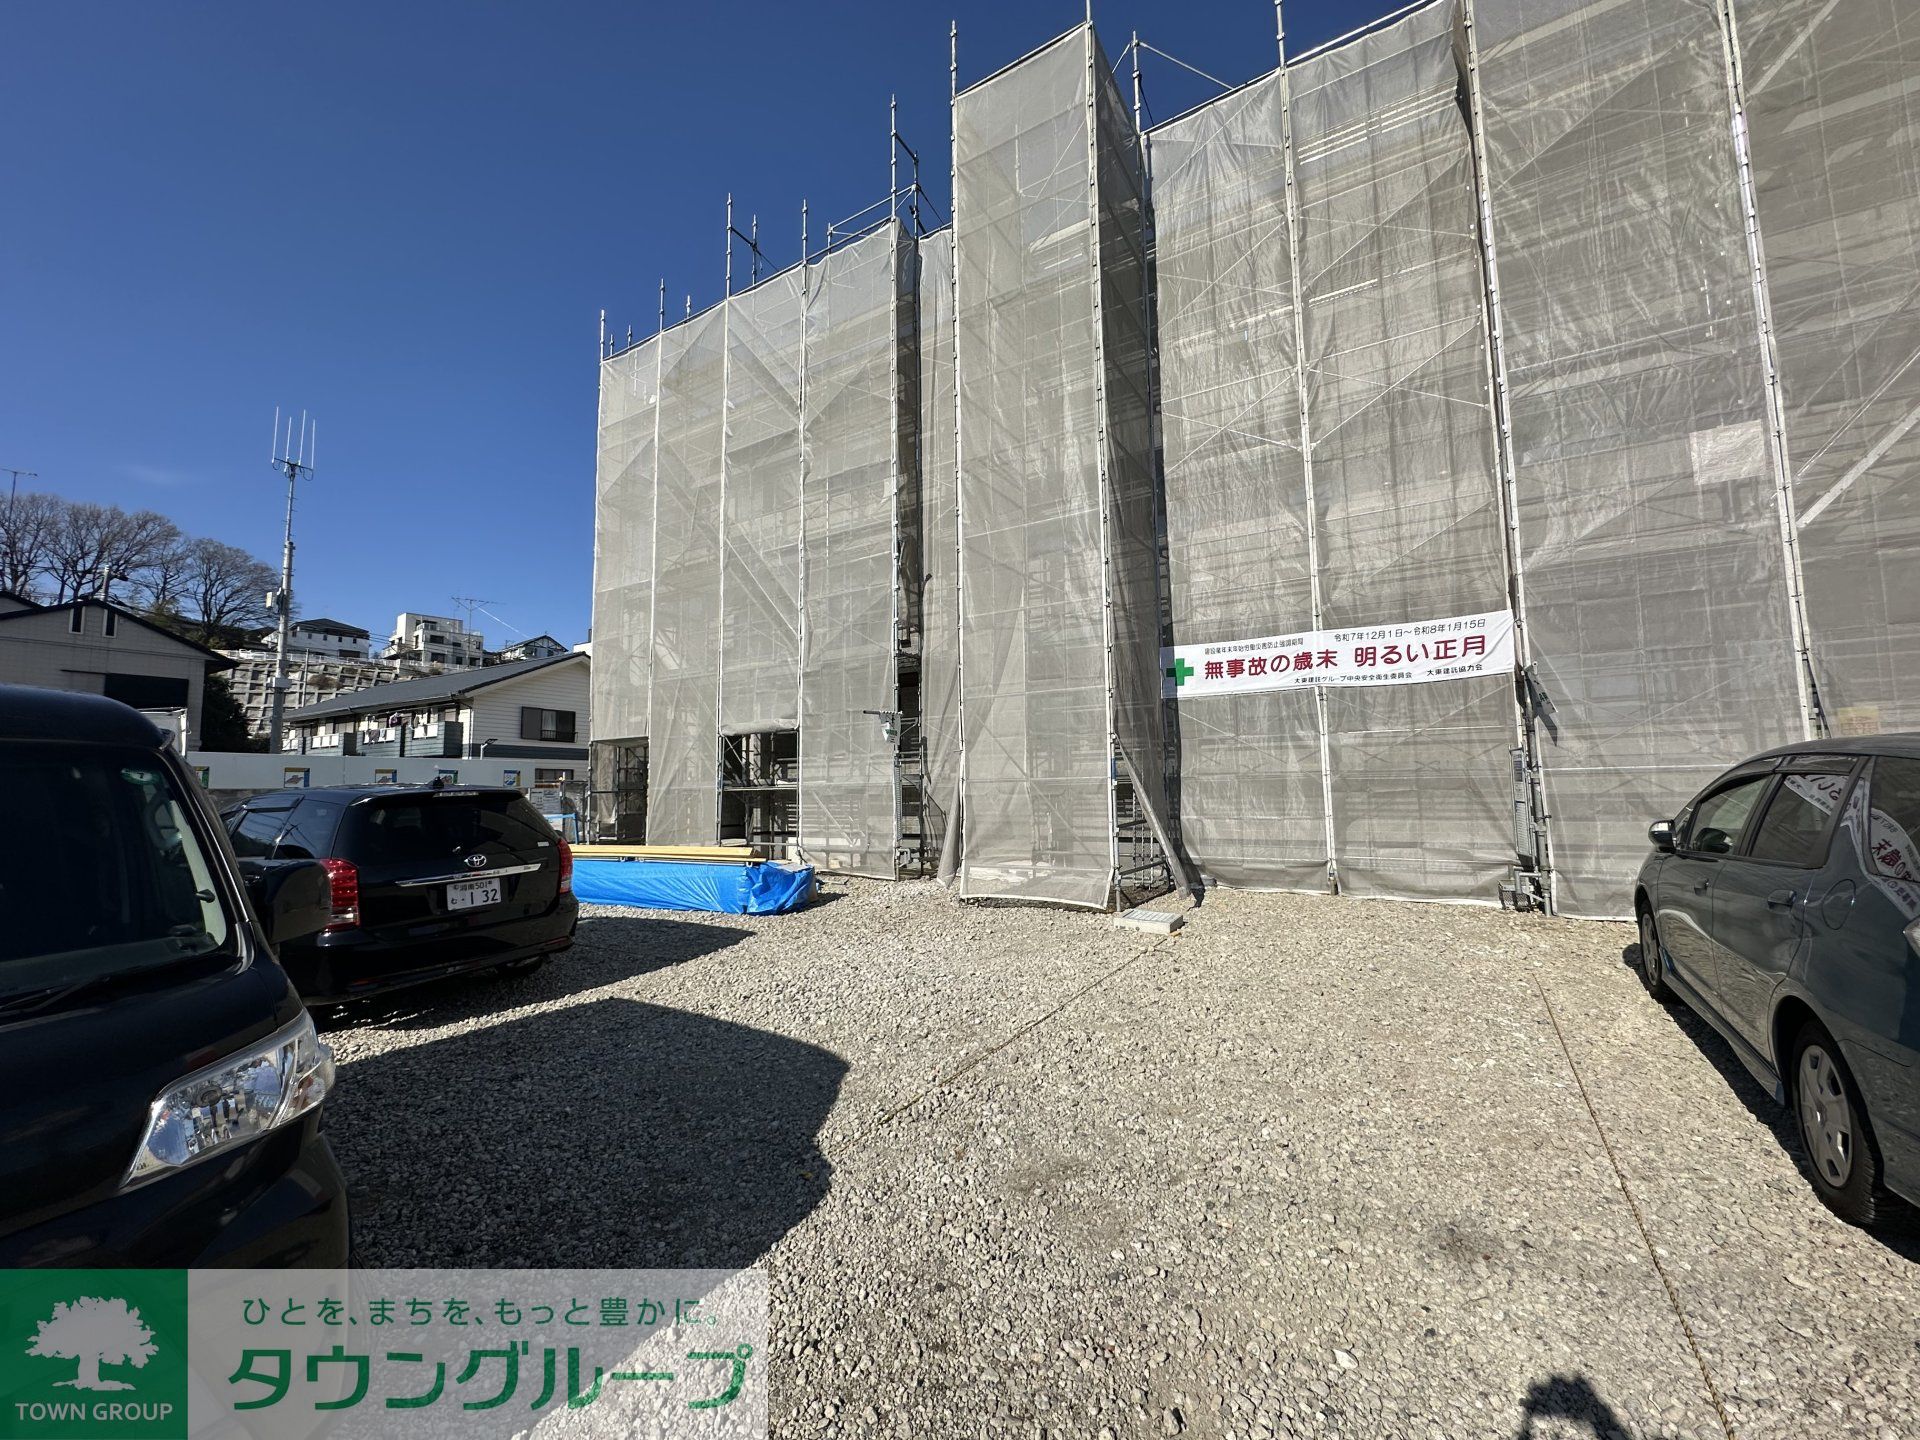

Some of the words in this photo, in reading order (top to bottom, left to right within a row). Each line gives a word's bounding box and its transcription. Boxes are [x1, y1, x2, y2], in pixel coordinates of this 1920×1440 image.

[1204, 649, 1338, 680] 無事故の歳末
[1354, 635, 1486, 667] 明るい正月
